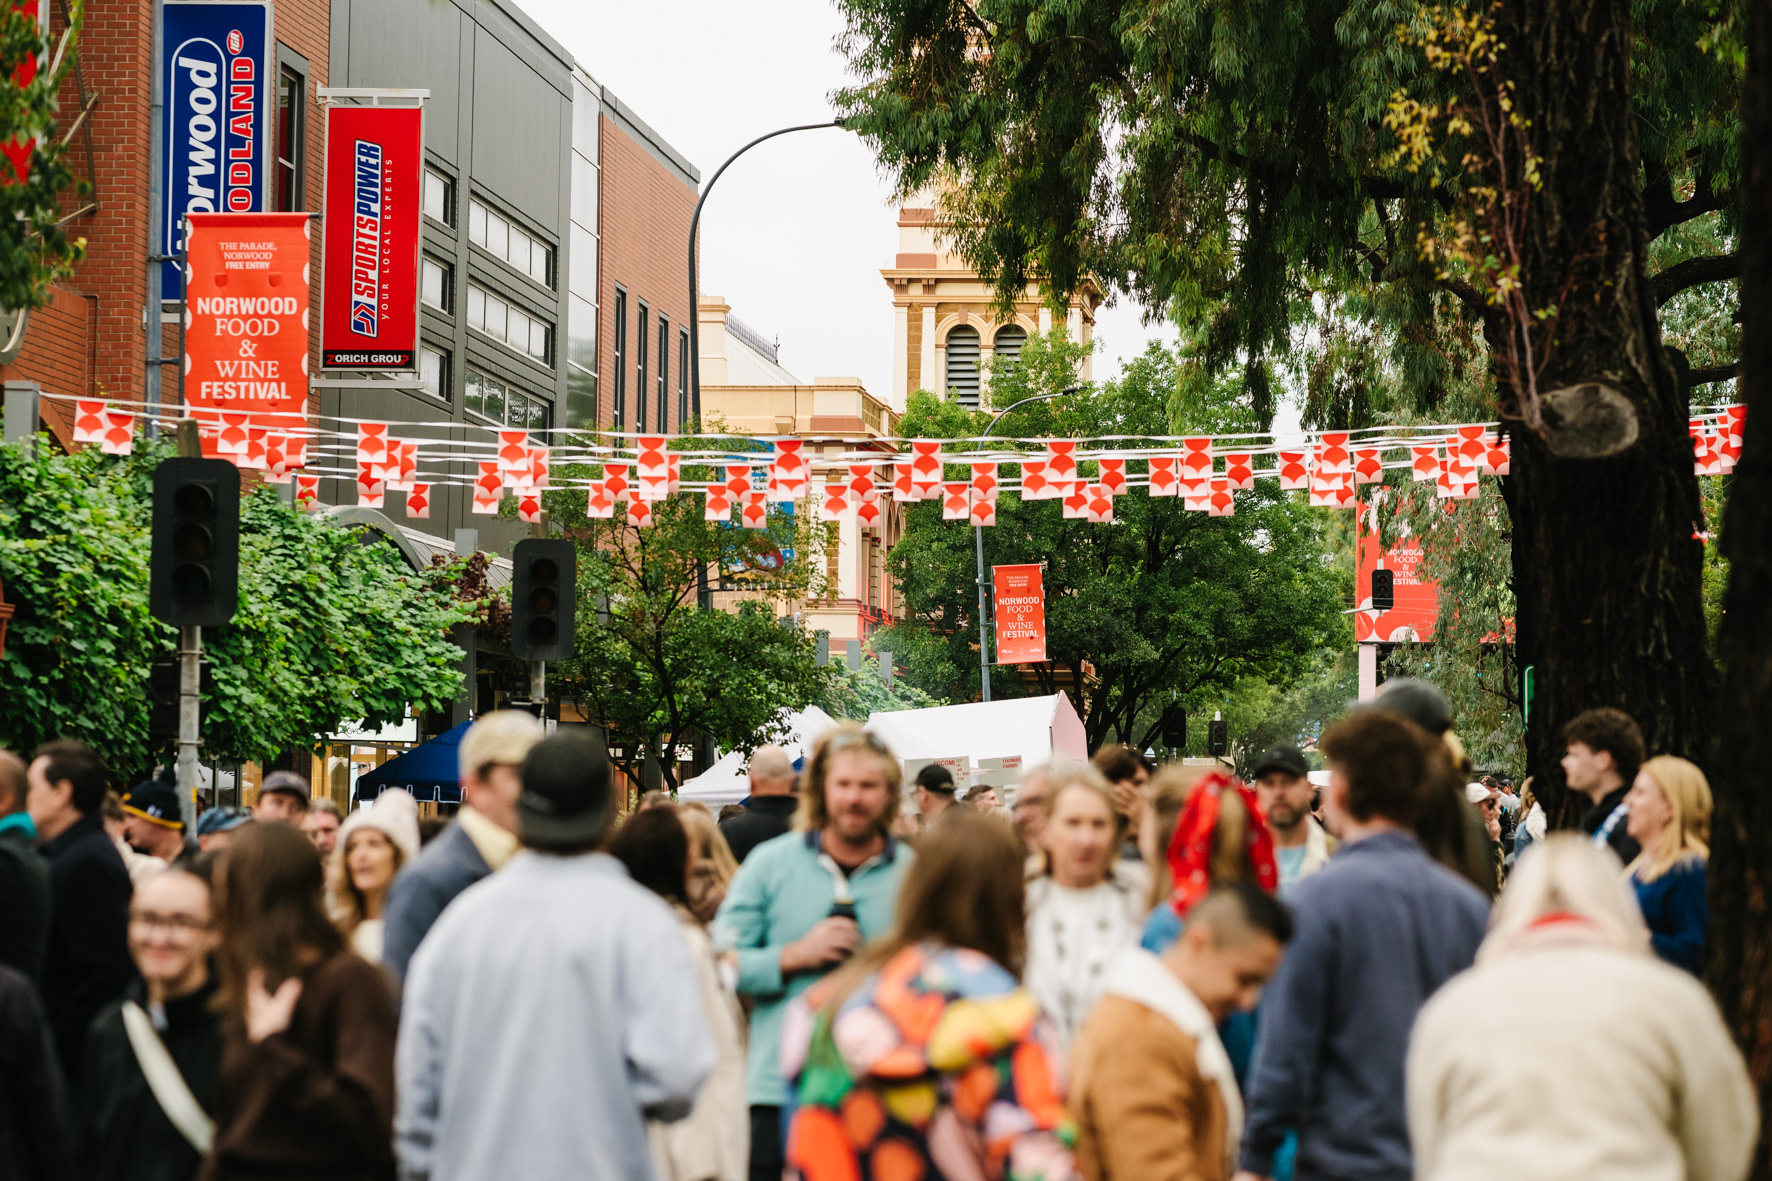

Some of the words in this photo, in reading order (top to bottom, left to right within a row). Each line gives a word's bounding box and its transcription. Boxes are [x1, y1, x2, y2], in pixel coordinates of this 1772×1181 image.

[230, 32, 240, 52] IGA
[227, 57, 255, 213] ODLAND
[177, 56, 217, 250] orwood
[384, 159, 393, 220] EXPERTS
[353, 141, 381, 299] SPORTSPOWER
[219, 242, 237, 250] THE
[239, 242, 277, 251] PARADE,
[382, 229, 391, 274] LOCAL
[223, 252, 273, 260] NORWOOD
[225, 261, 245, 270] FREE
[246, 261, 270, 270] ENTRY
[197, 297, 297, 315] NORWOOD
[380, 282, 390, 320] YOUR
[214, 318, 280, 336] FOOD
[238, 339, 258, 358] &
[326, 354, 369, 365] ZORICH
[370, 354, 409, 365] GROUP
[214, 360, 280, 379] WINE
[201, 381, 292, 400] FESTIVAL
[1393, 556, 1418, 564] FOOD
[1402, 563, 1410, 571] &
[1392, 578, 1422, 586] ESTIVAL
[999, 596, 1040, 606] NORWOOD
[1007, 605, 1033, 614] FOOD
[1016, 613, 1025, 622] &
[1007, 621, 1034, 630] WINE
[1002, 629, 1040, 639] FESTIVAL
